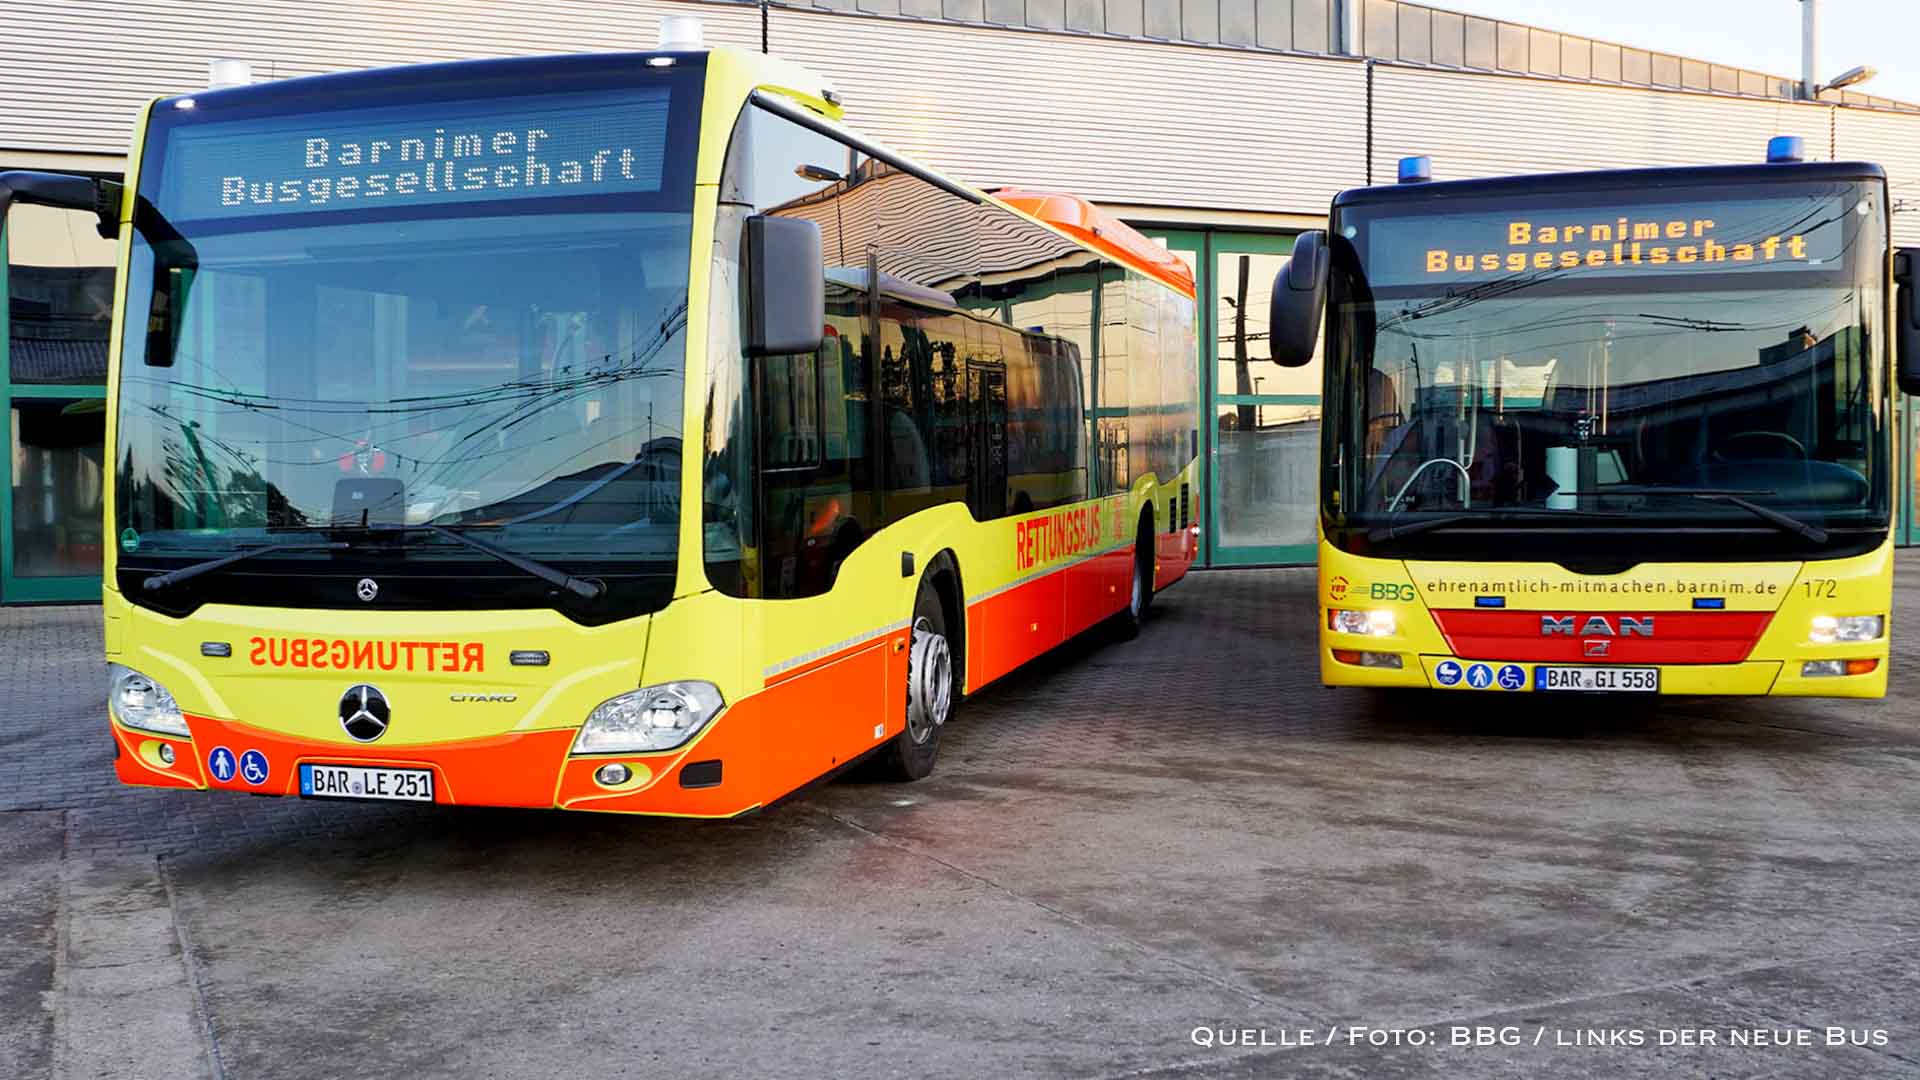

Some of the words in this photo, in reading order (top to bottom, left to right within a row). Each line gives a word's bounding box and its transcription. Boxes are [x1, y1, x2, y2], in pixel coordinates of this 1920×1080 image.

[304, 127, 550, 169] Barnimer
[221, 148, 635, 207] Busgesellschaft
[1507, 217, 1715, 246] Barnimer
[1425, 234, 1809, 273] Busgesellschaft
[1015, 503, 1101, 572] RETTUNGSBUS
[1370, 583, 1415, 601] BBG
[1426, 578, 1777, 595] ehrenamtlich-mitmachen.barnim.de
[1803, 579, 1836, 599] 172
[1541, 615, 1655, 637] MAN
[1548, 670, 1582, 687] BAR
[1595, 671, 1617, 688] GI
[1622, 671, 1656, 689] 558
[449, 694, 518, 702] CITARO
[313, 769, 350, 794] BAR
[364, 772, 389, 795] LE
[394, 773, 431, 798] 251
